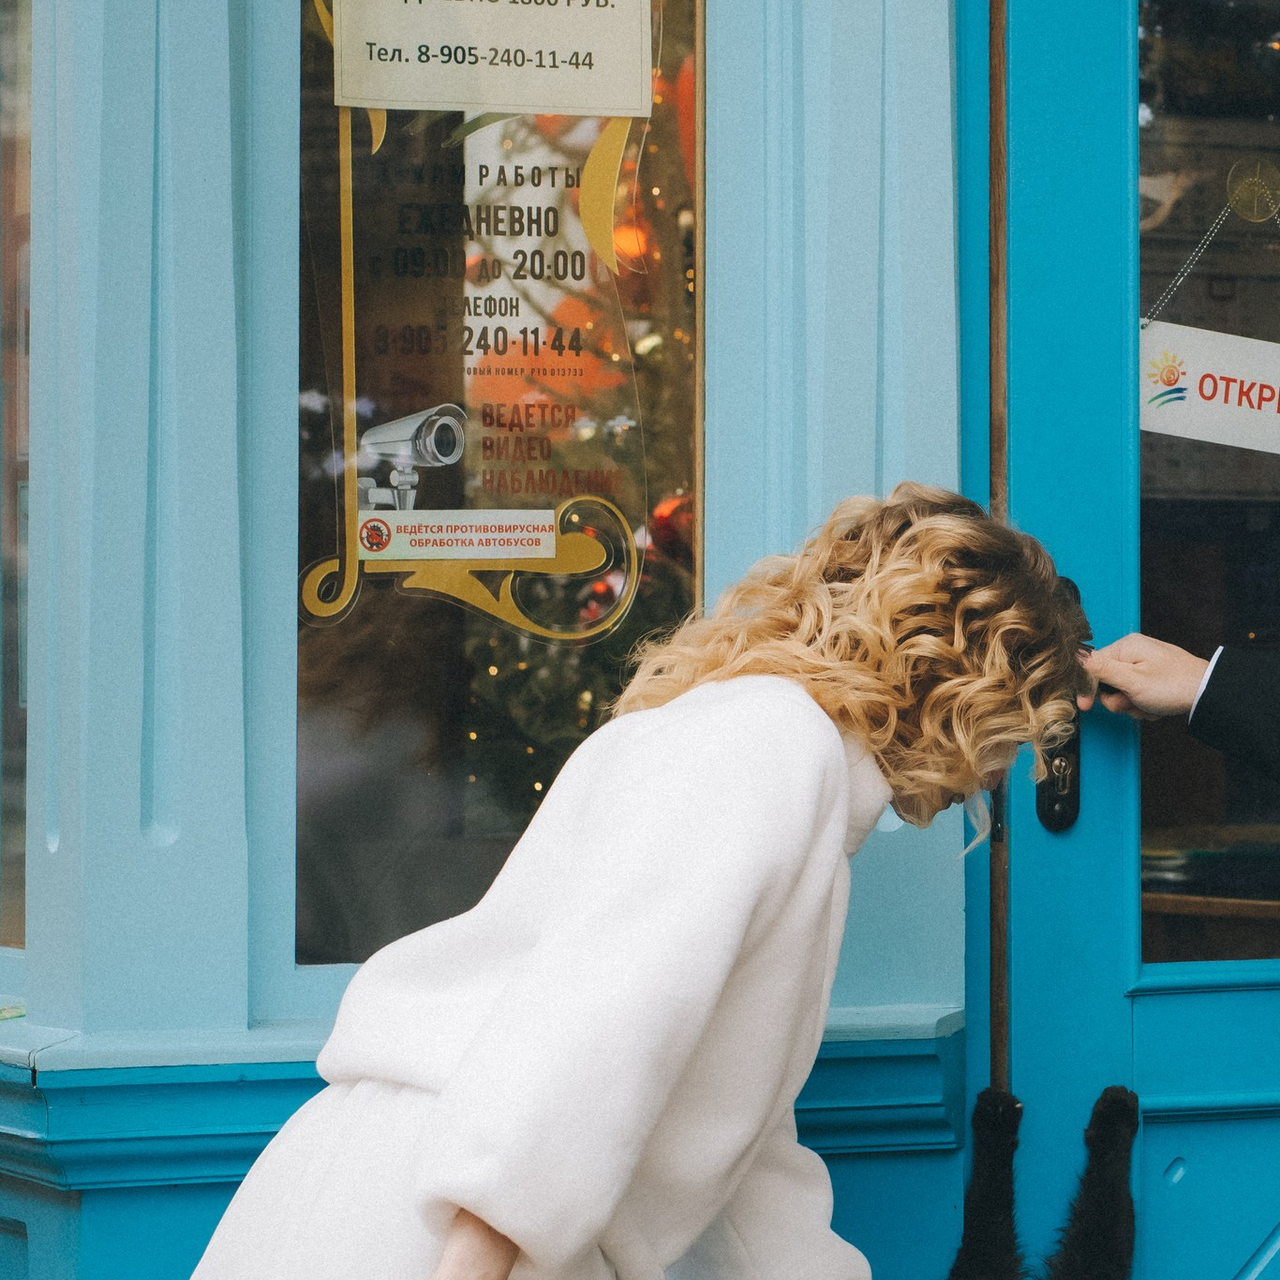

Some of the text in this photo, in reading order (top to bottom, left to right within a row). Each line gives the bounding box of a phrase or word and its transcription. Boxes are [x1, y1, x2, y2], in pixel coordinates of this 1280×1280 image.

[366, 41, 594, 70] Тел. 8-905-240-11-44
[478, 164, 581, 188] РАБОТЫ
[512, 249, 586, 281] 20:00
[494, 367, 525, 377] НОМЕР
[482, 403, 577, 433] ВЕДЕТСЯ
[482, 436, 552, 464] ВИДЕО
[396, 523, 555, 535] ВЕДЁТСЯ ПРОТИВОВИРУСНАЯ
[409, 537, 542, 548] ОБРАБОТКА АВТОБУСОВ
